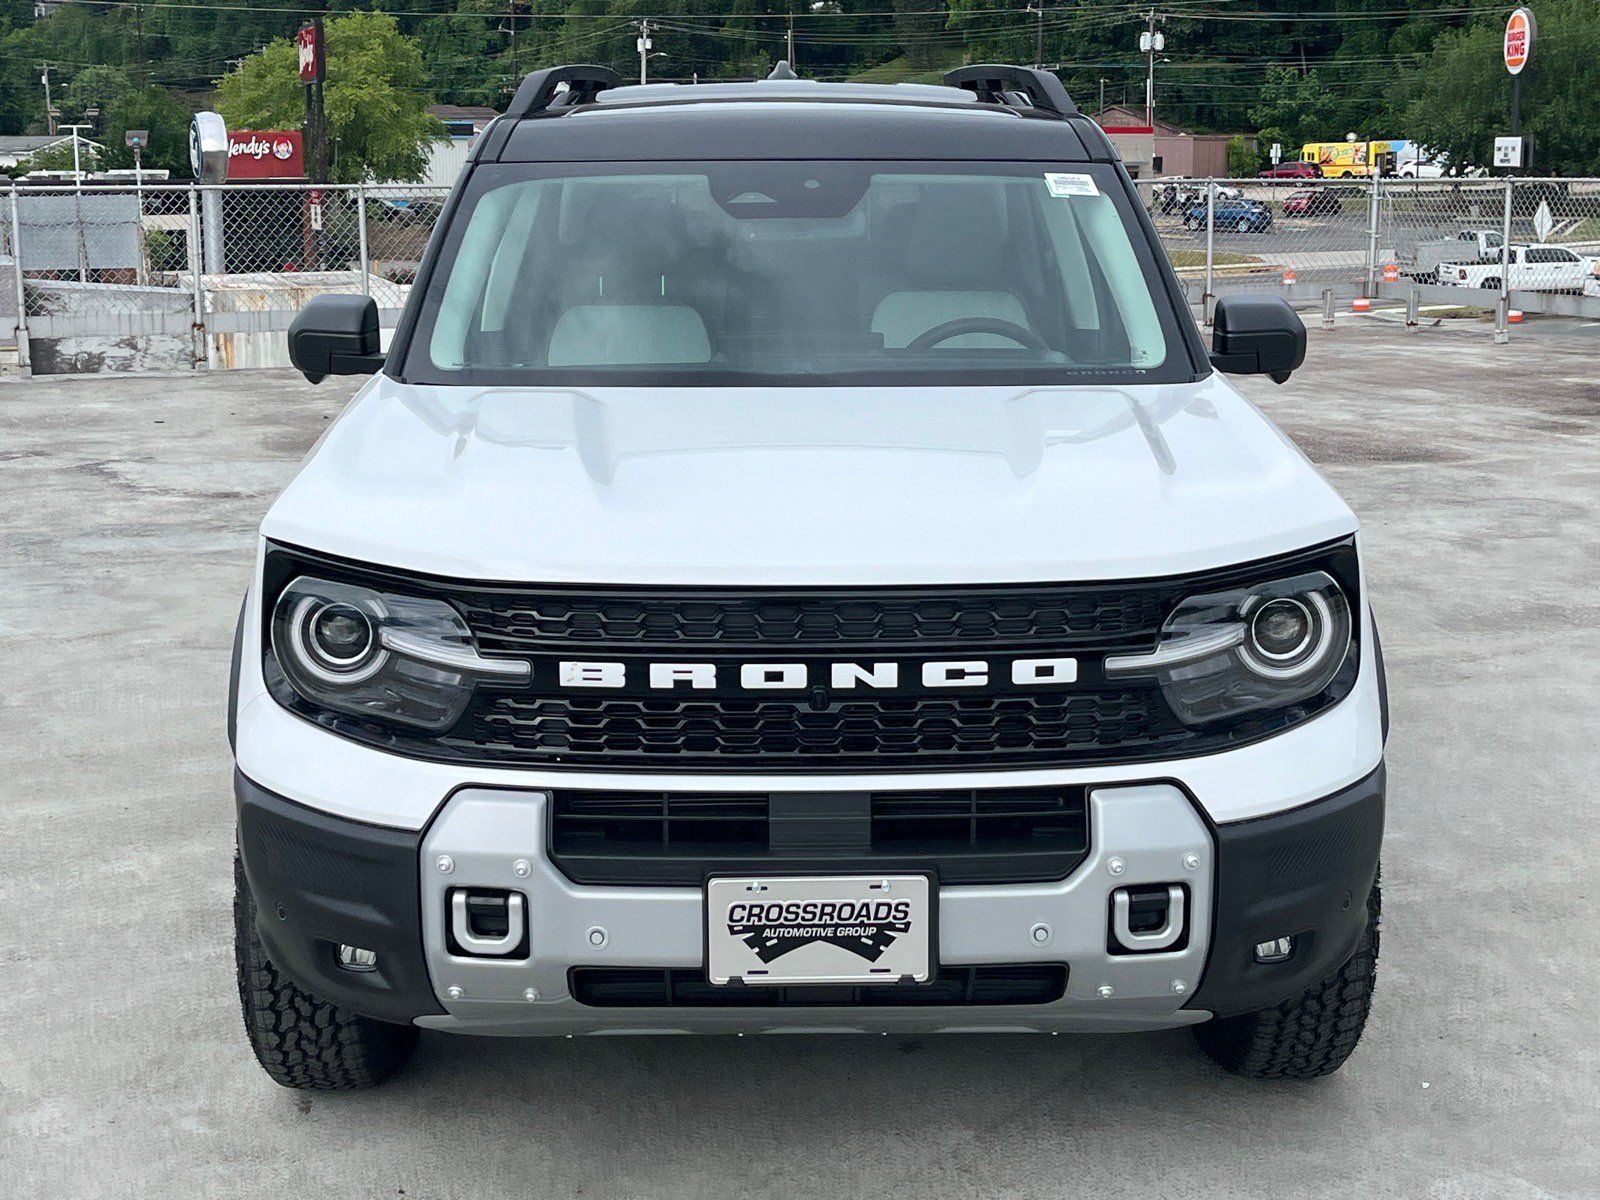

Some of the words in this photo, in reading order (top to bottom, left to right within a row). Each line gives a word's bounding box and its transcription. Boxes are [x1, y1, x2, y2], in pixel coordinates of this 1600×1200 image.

[1507, 42, 1525, 57] KING
[559, 658, 1077, 689] BRONCO
[728, 901, 910, 924] CROSSROADS
[762, 927, 834, 938] AUTOMOTIVE
[836, 927, 877, 937] GROUP
